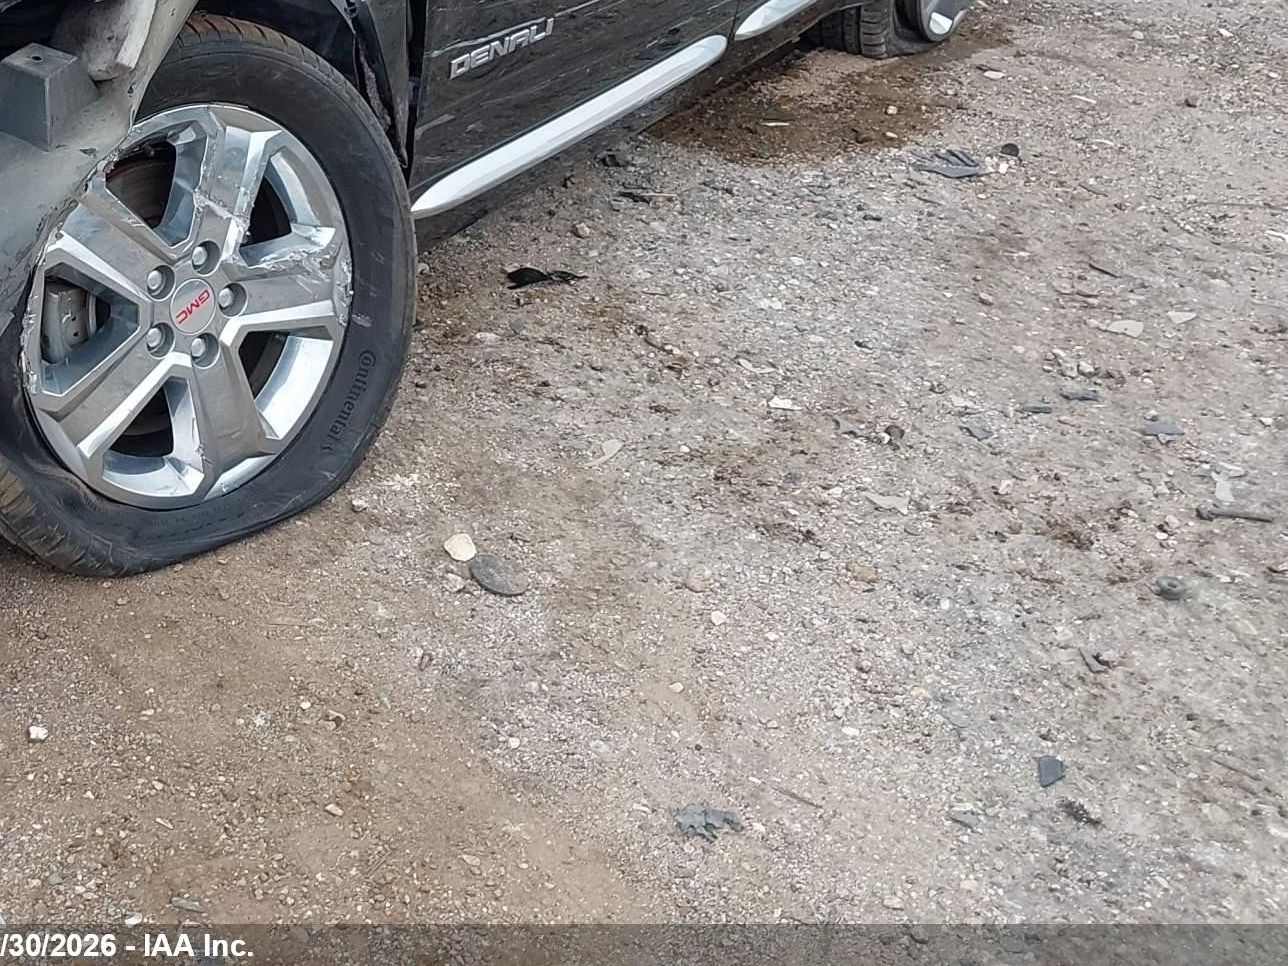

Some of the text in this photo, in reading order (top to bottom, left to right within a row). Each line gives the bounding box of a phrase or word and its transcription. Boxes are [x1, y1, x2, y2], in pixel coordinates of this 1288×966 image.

[449, 17, 554, 80] DENALI
[175, 289, 211, 324] GMC
[327, 349, 377, 442] Continental
